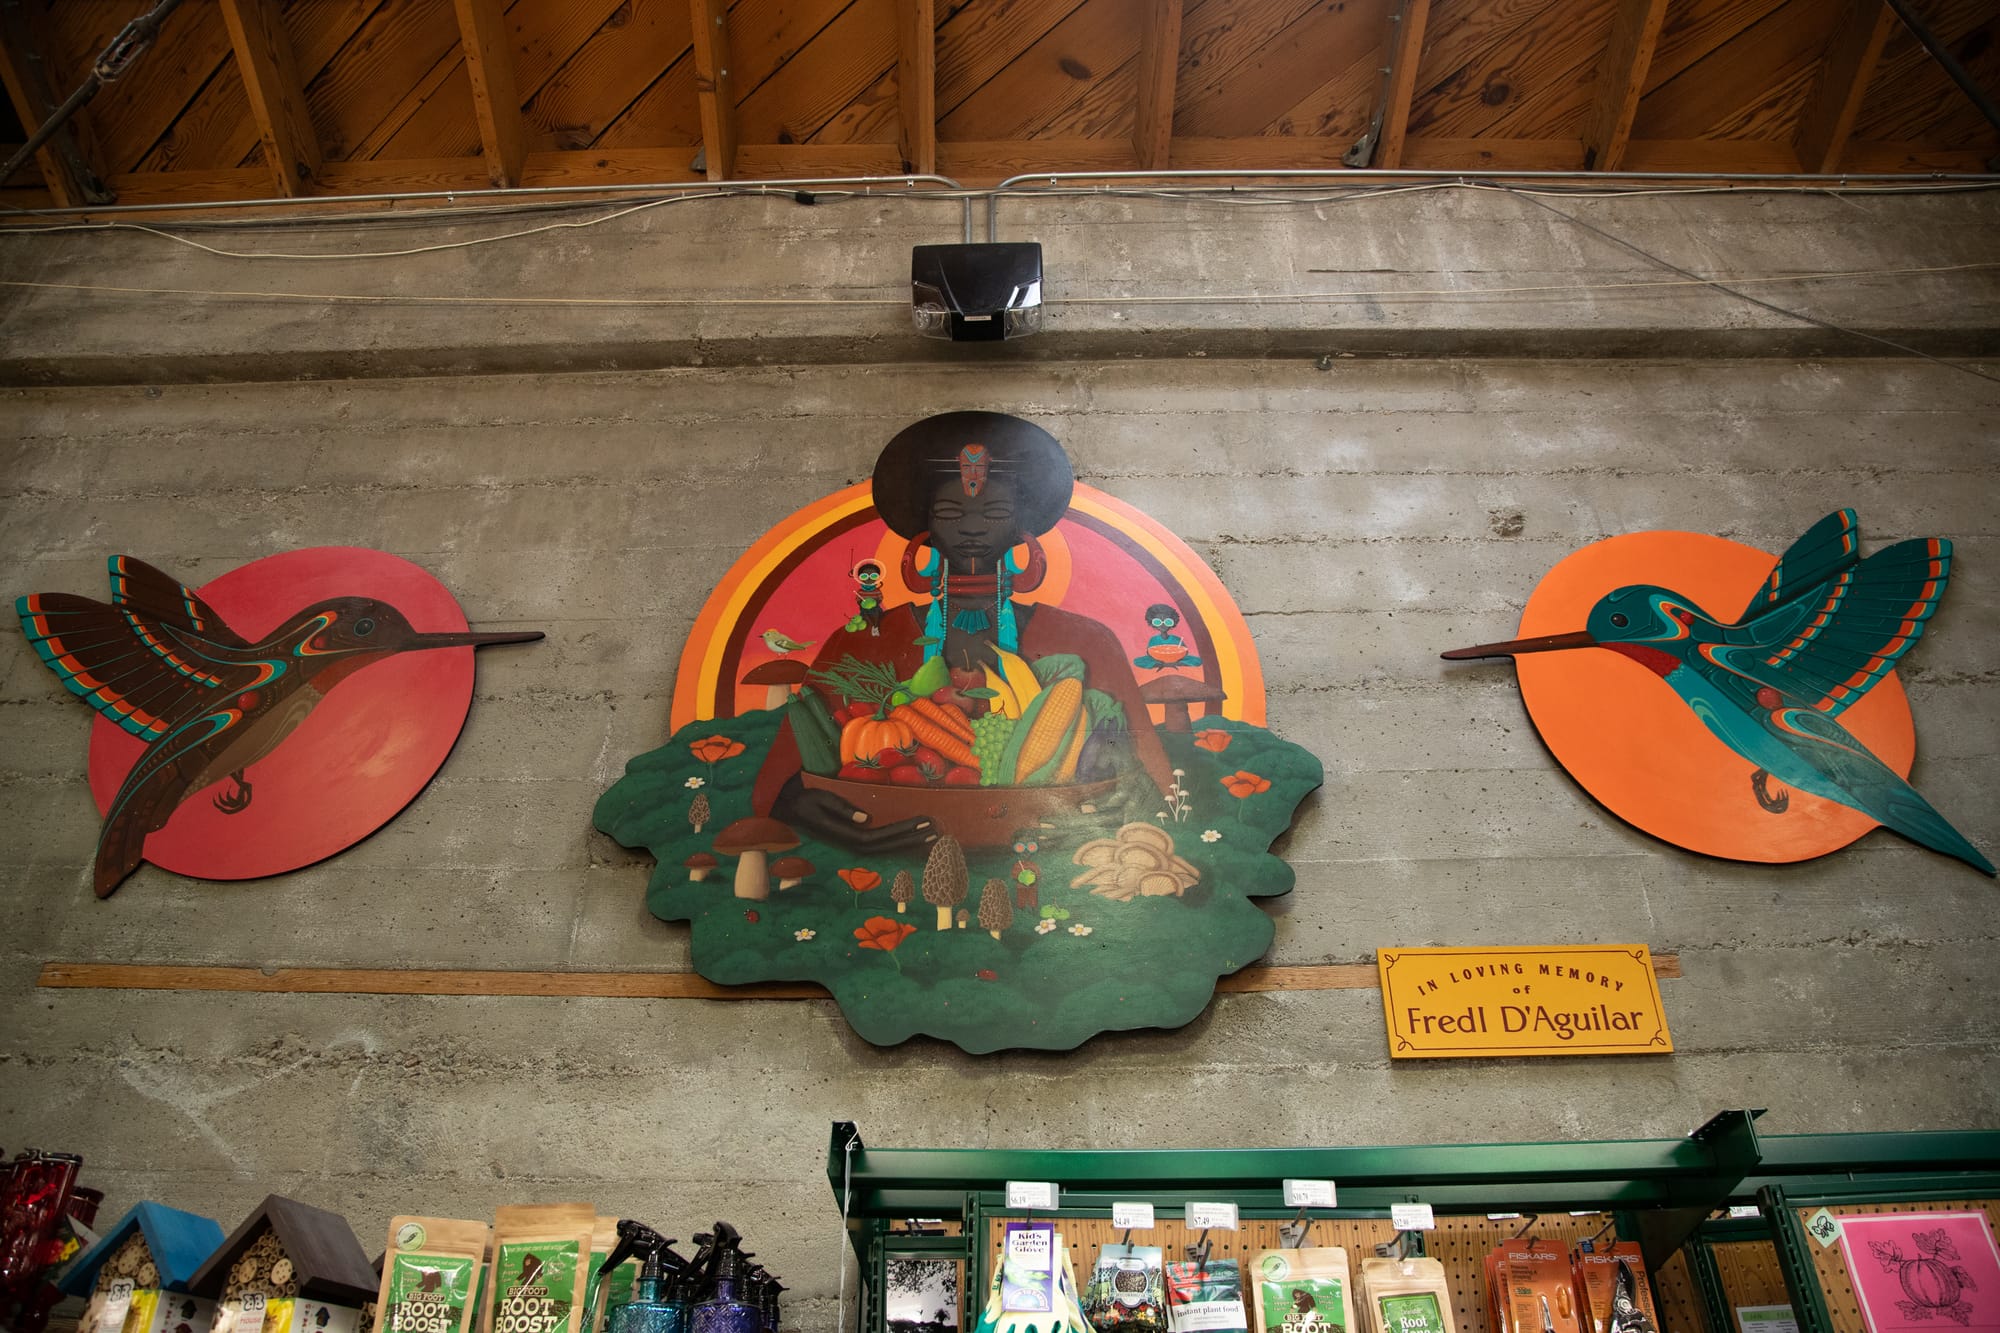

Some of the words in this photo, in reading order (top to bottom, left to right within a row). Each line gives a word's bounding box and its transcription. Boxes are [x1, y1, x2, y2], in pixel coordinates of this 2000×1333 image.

[1416, 979, 1438, 996] IN
[1450, 963, 1523, 984] LOVING
[1538, 963, 1625, 992] MEMORY
[1512, 984, 1532, 995] of
[1499, 1003, 1645, 1041] D'Aguilar
[1018, 1232, 1042, 1240] Kid's
[1508, 1252, 1558, 1261] FISKARS
[408, 1293, 422, 1301] BIG
[423, 1294, 445, 1302] FOOT
[509, 1287, 522, 1295] BIG
[399, 1301, 450, 1318] ROOT
[499, 1297, 555, 1316] ROOT
[1176, 1307, 1202, 1318] instant
[1203, 1305, 1221, 1316] plant
[1222, 1304, 1240, 1313] food
[391, 1315, 453, 1333] BOOST
[495, 1315, 558, 1333] BOOST
[1400, 1315, 1429, 1329] Root
